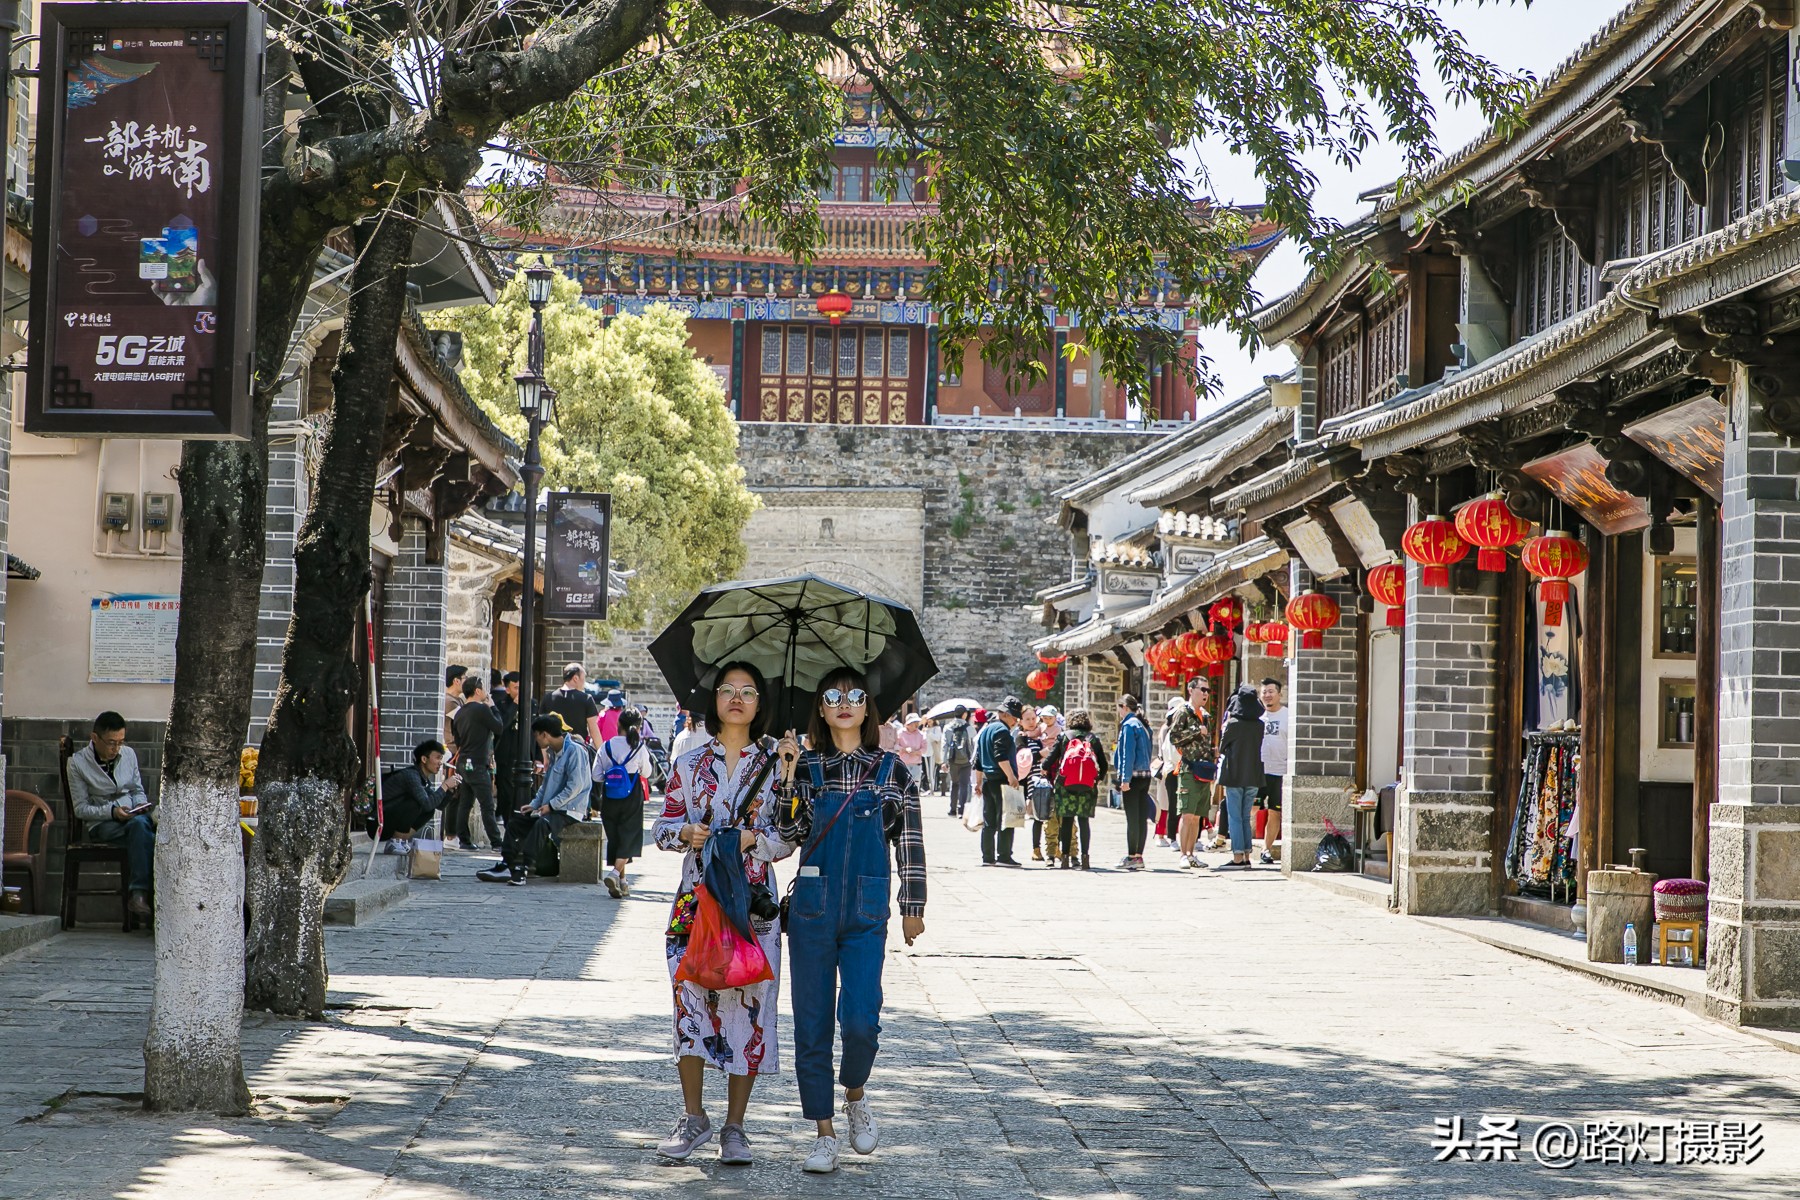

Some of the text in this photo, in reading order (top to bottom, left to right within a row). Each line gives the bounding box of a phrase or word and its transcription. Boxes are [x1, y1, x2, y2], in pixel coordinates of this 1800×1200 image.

[84, 121, 184, 165] 一部手机
[129, 139, 210, 199] 游云南
[80, 312, 111, 323] 中国电信
[148, 356, 185, 366] 赋能未来
[1547, 601, 1560, 613] 30
